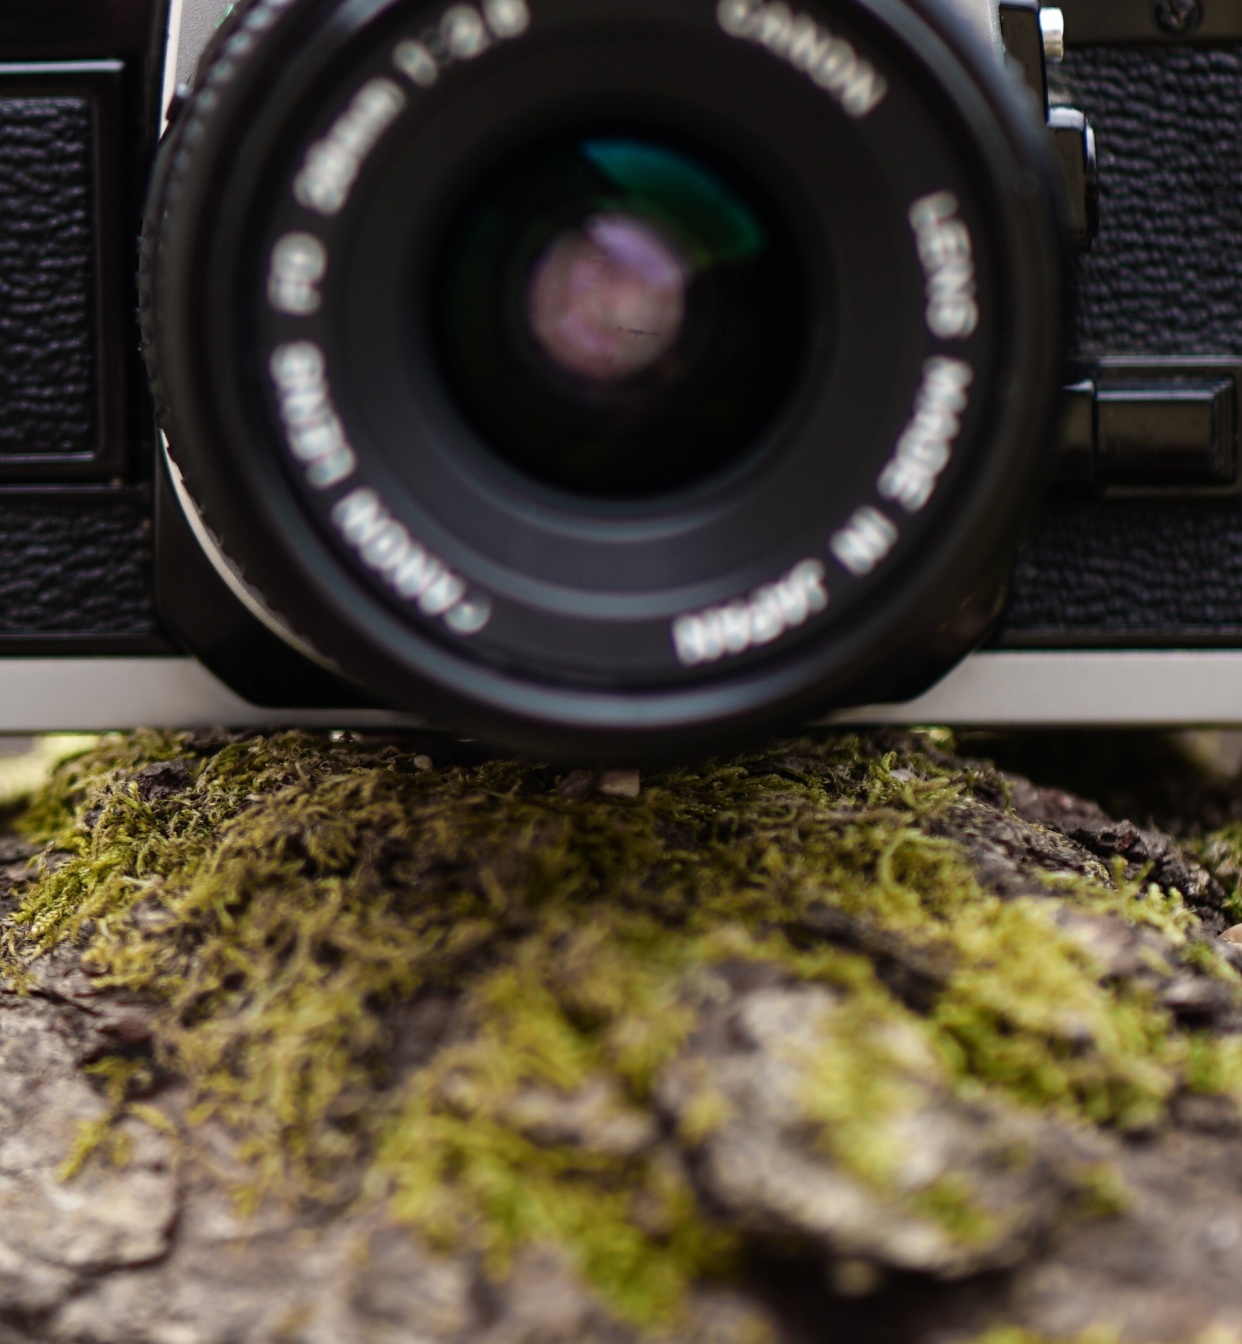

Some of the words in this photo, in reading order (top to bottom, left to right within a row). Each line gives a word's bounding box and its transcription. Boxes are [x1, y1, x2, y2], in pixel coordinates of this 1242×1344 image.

[908, 190, 979, 339] LENS
[270, 341, 356, 490] LENS
[877, 356, 973, 513] MADE
[332, 488, 491, 634] CANON
[672, 558, 828, 666] JAPAN
[829, 506, 898, 577] IN
